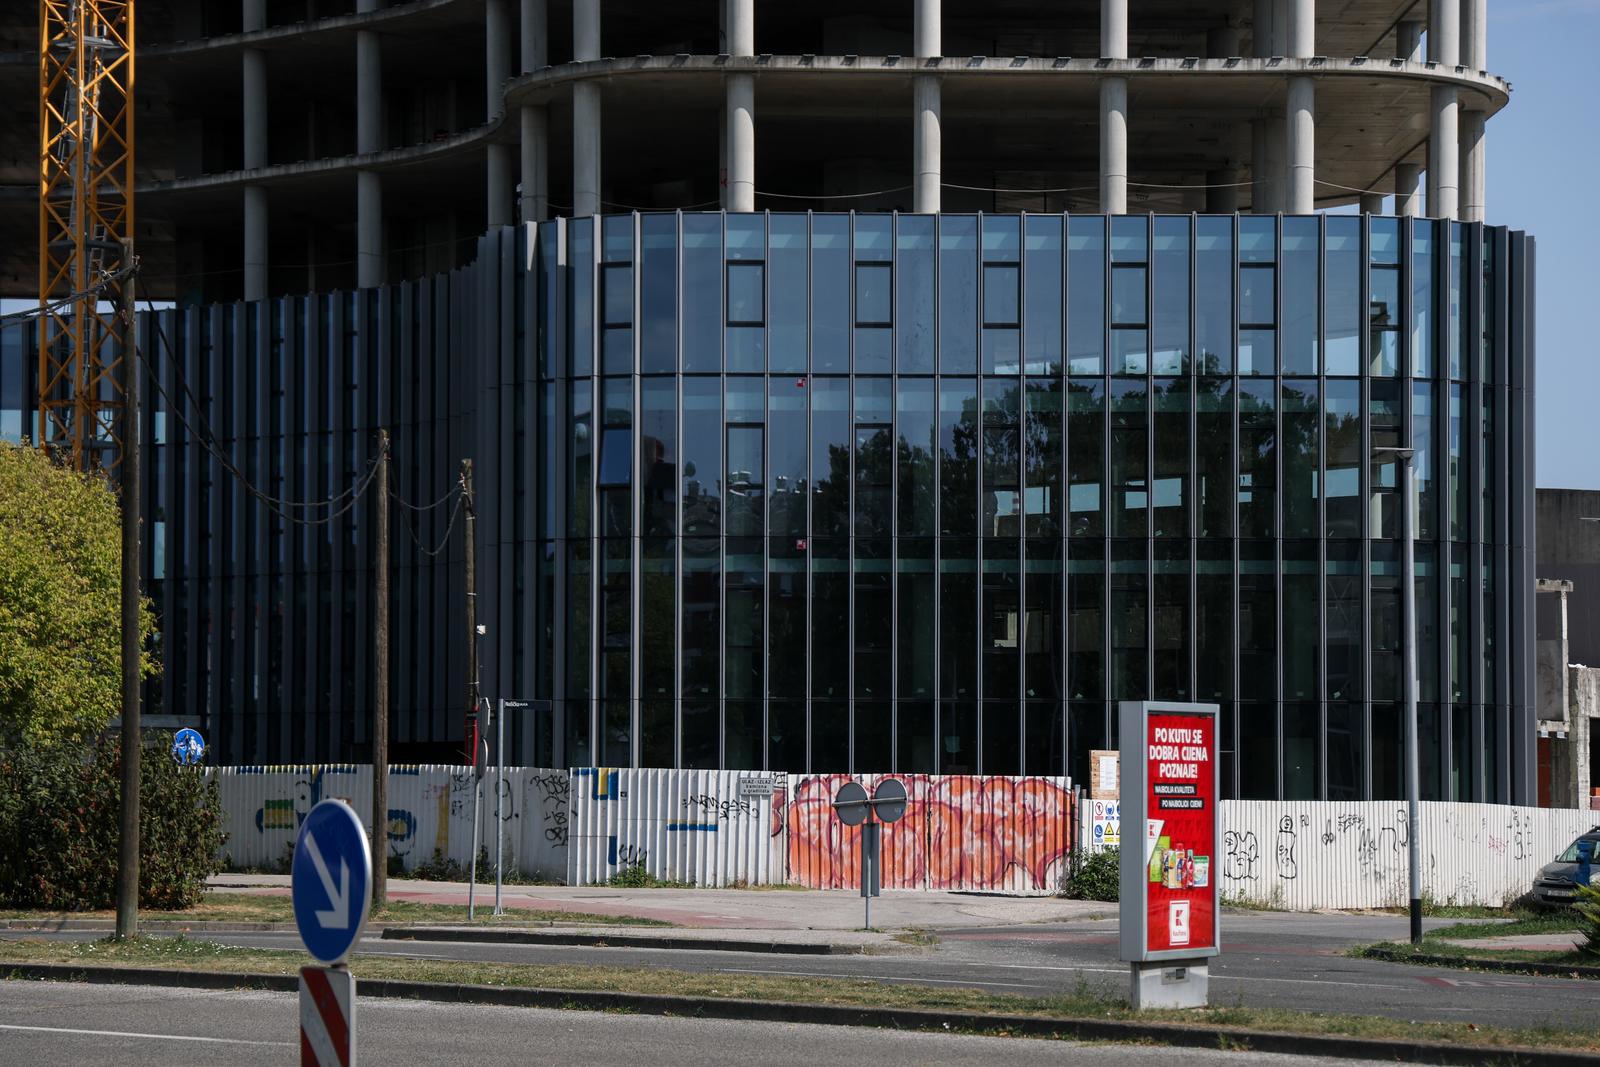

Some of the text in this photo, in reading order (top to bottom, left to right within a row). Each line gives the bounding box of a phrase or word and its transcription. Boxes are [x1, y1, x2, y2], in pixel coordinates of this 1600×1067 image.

[1155, 727, 1202, 744] PO KUTU SE
[1149, 745, 1208, 761] DOBRA CIJENA
[1160, 763, 1197, 778] POZNAJE!
